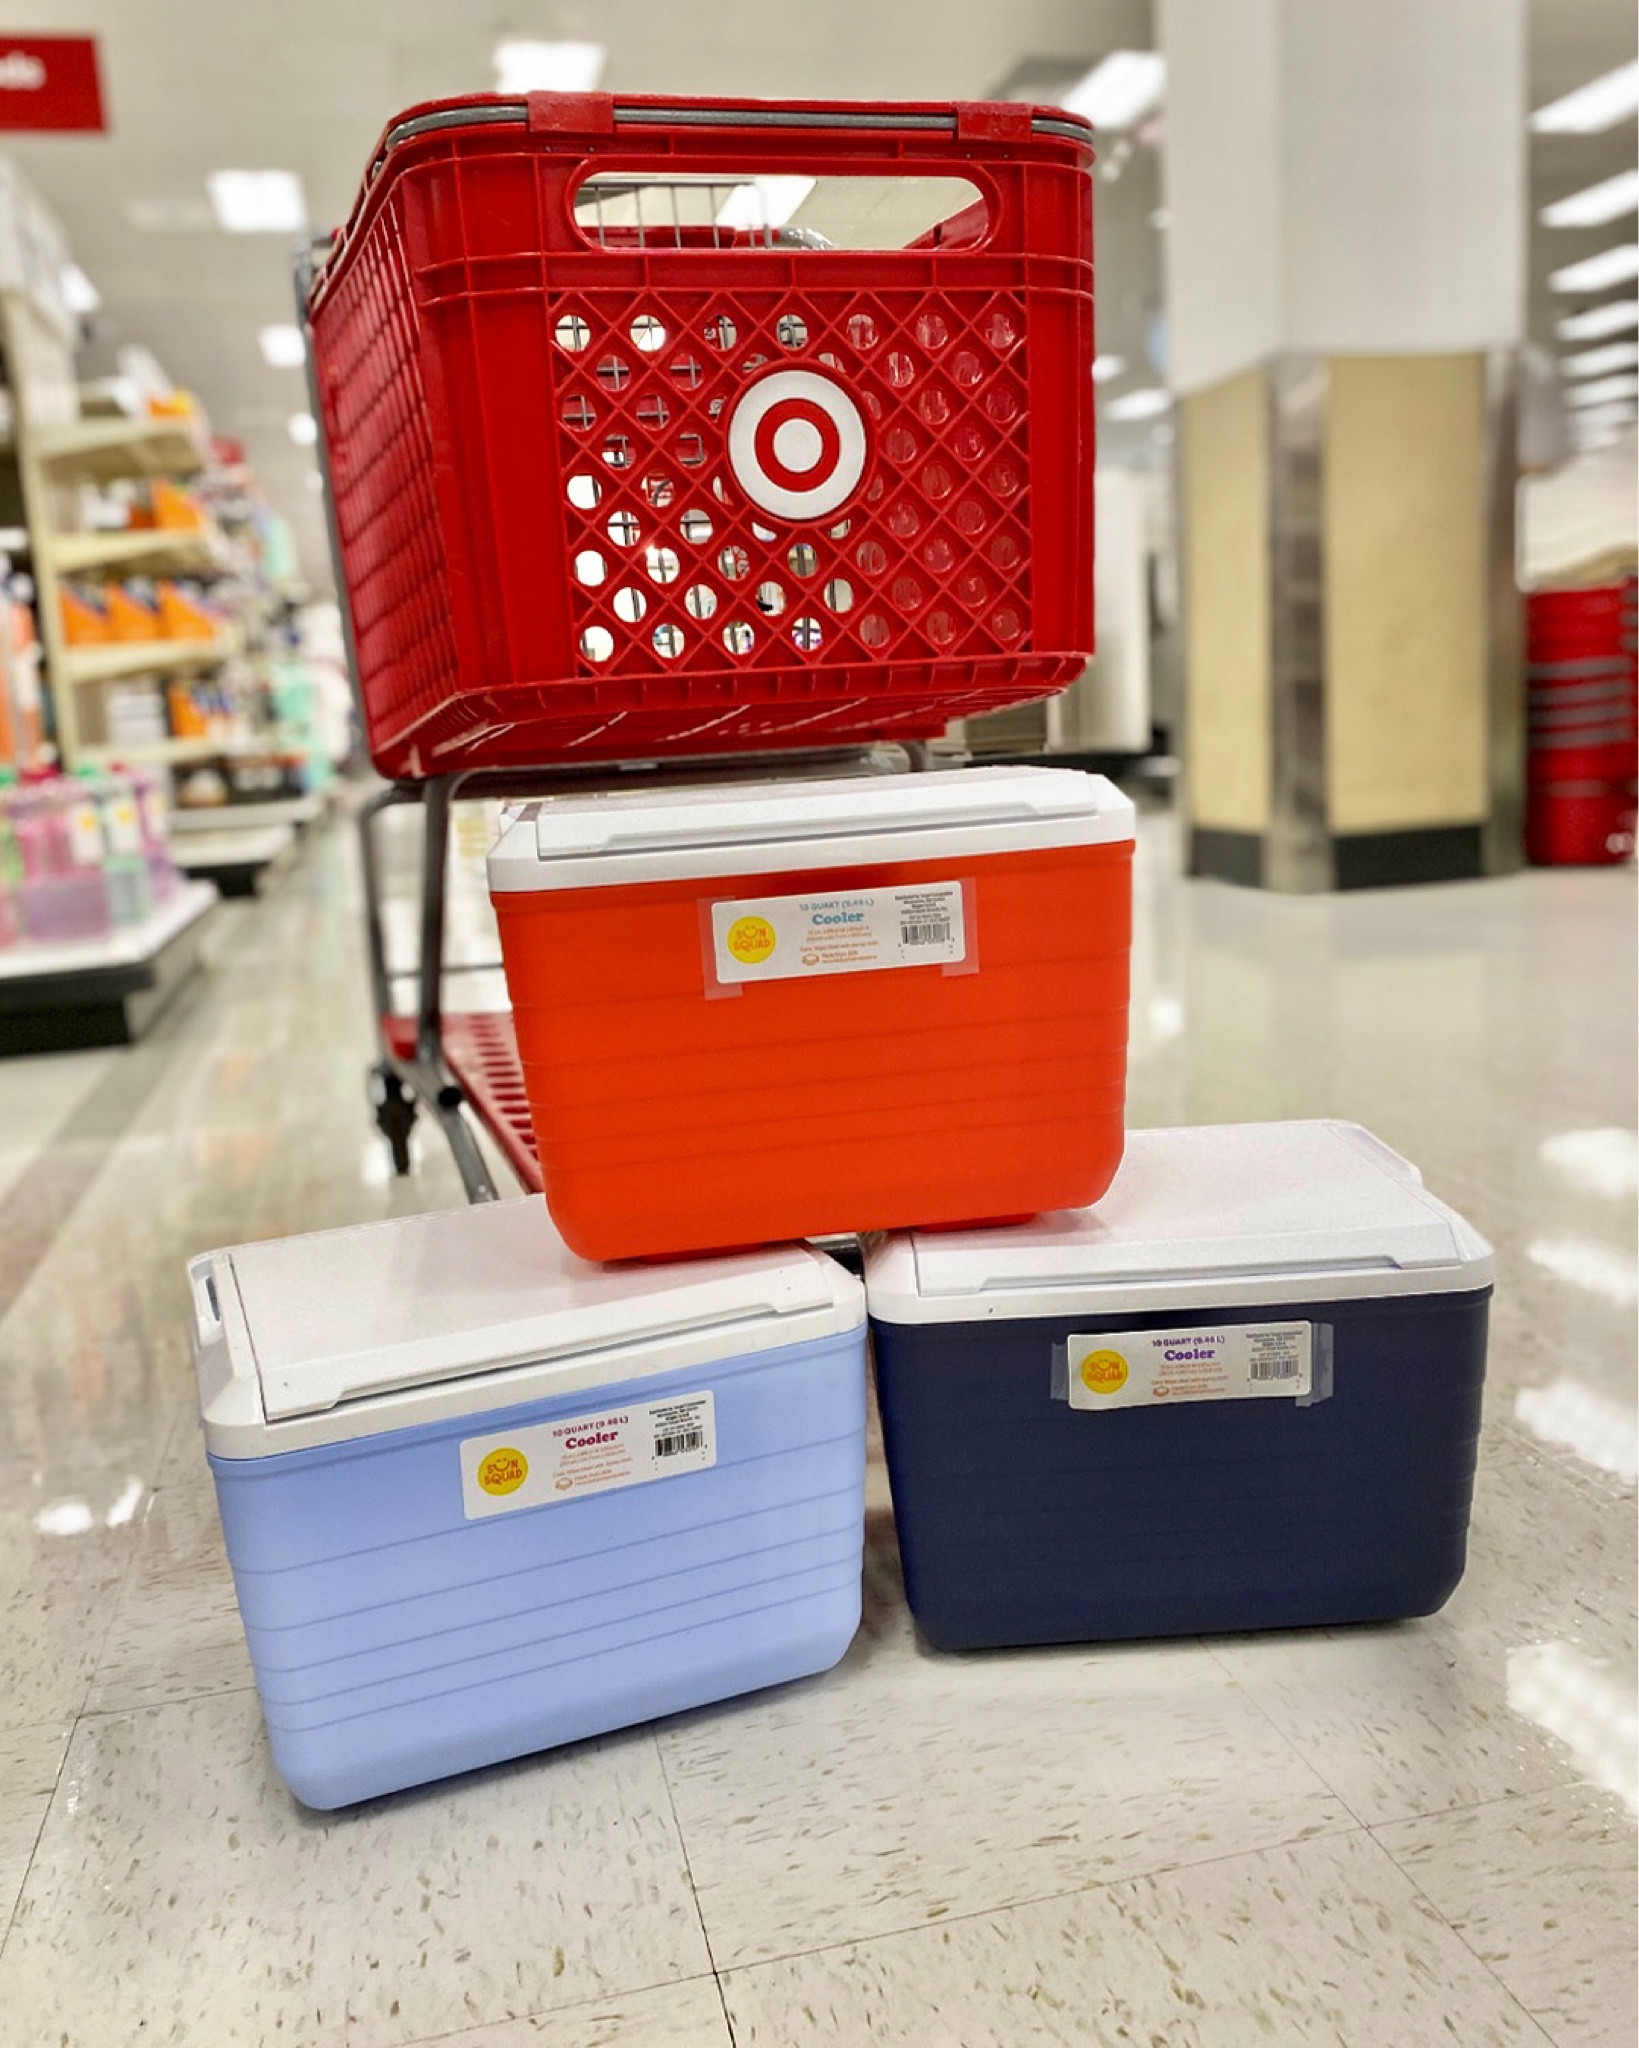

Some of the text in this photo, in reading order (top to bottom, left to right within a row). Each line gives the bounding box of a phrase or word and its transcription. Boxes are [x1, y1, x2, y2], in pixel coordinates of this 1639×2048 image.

[799, 903, 809, 911] 10
[811, 900, 840, 910] QUART
[811, 911, 864, 926] Cooler
[736, 926, 767, 940] SUN
[733, 938, 772, 953] SQUAD
[1152, 1339, 1163, 1347] 10
[1163, 1337, 1192, 1347] QUART
[1164, 1348, 1216, 1361] Cooler
[1090, 1360, 1120, 1372] SUN
[1086, 1370, 1124, 1384] SQUAD
[552, 1428, 563, 1437] 10
[563, 1422, 594, 1435] QUART
[565, 1431, 619, 1449] Cooler
[486, 1458, 518, 1474] SUN
[483, 1469, 523, 1486] SQUAD
